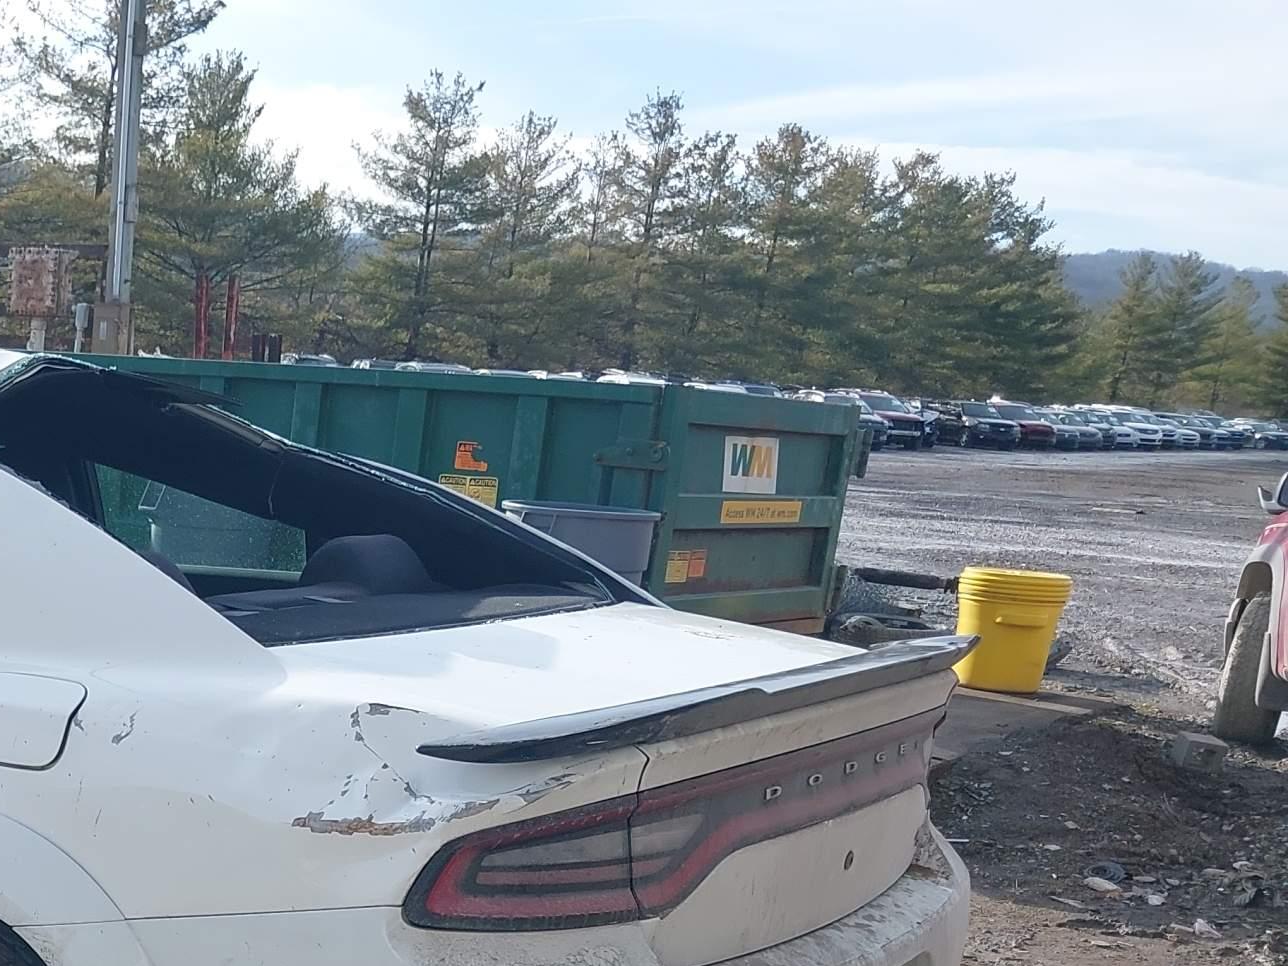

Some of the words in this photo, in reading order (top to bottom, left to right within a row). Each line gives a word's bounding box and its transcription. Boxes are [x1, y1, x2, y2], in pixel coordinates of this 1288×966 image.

[730, 443, 773, 479] WM
[445, 477, 466, 485] CAUTION
[765, 743, 907, 801] DODGE
